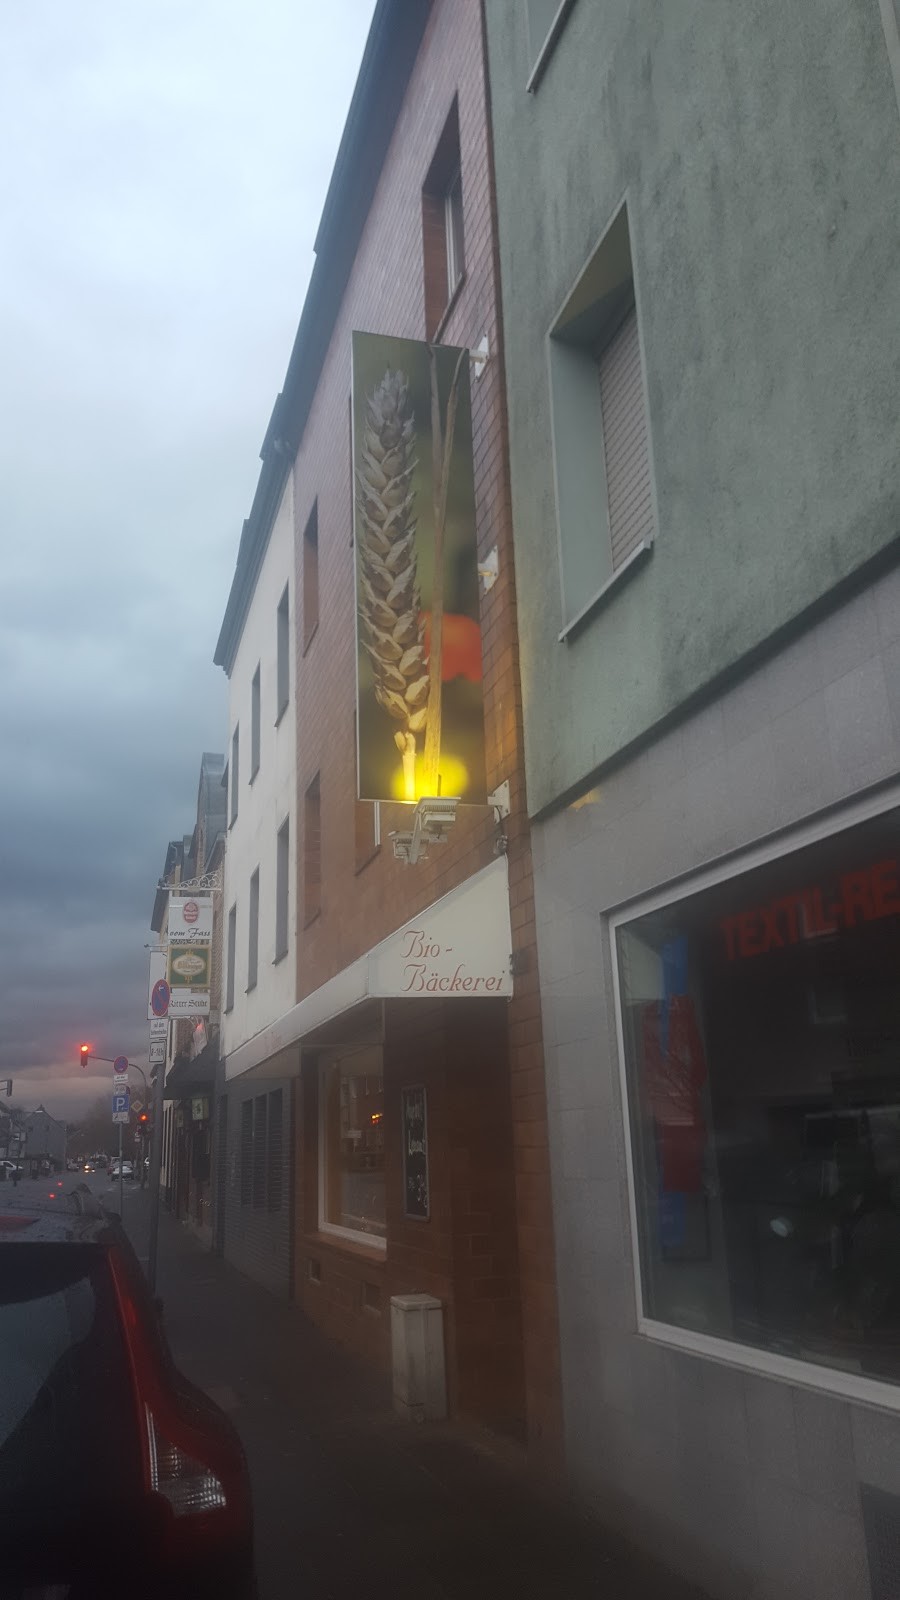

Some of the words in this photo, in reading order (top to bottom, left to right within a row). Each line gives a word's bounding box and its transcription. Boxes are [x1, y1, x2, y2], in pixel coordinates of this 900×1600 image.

[401, 930, 453, 958] Bio-
[401, 963, 505, 992] Bäckerei
[116, 1097, 126, 1112] P
